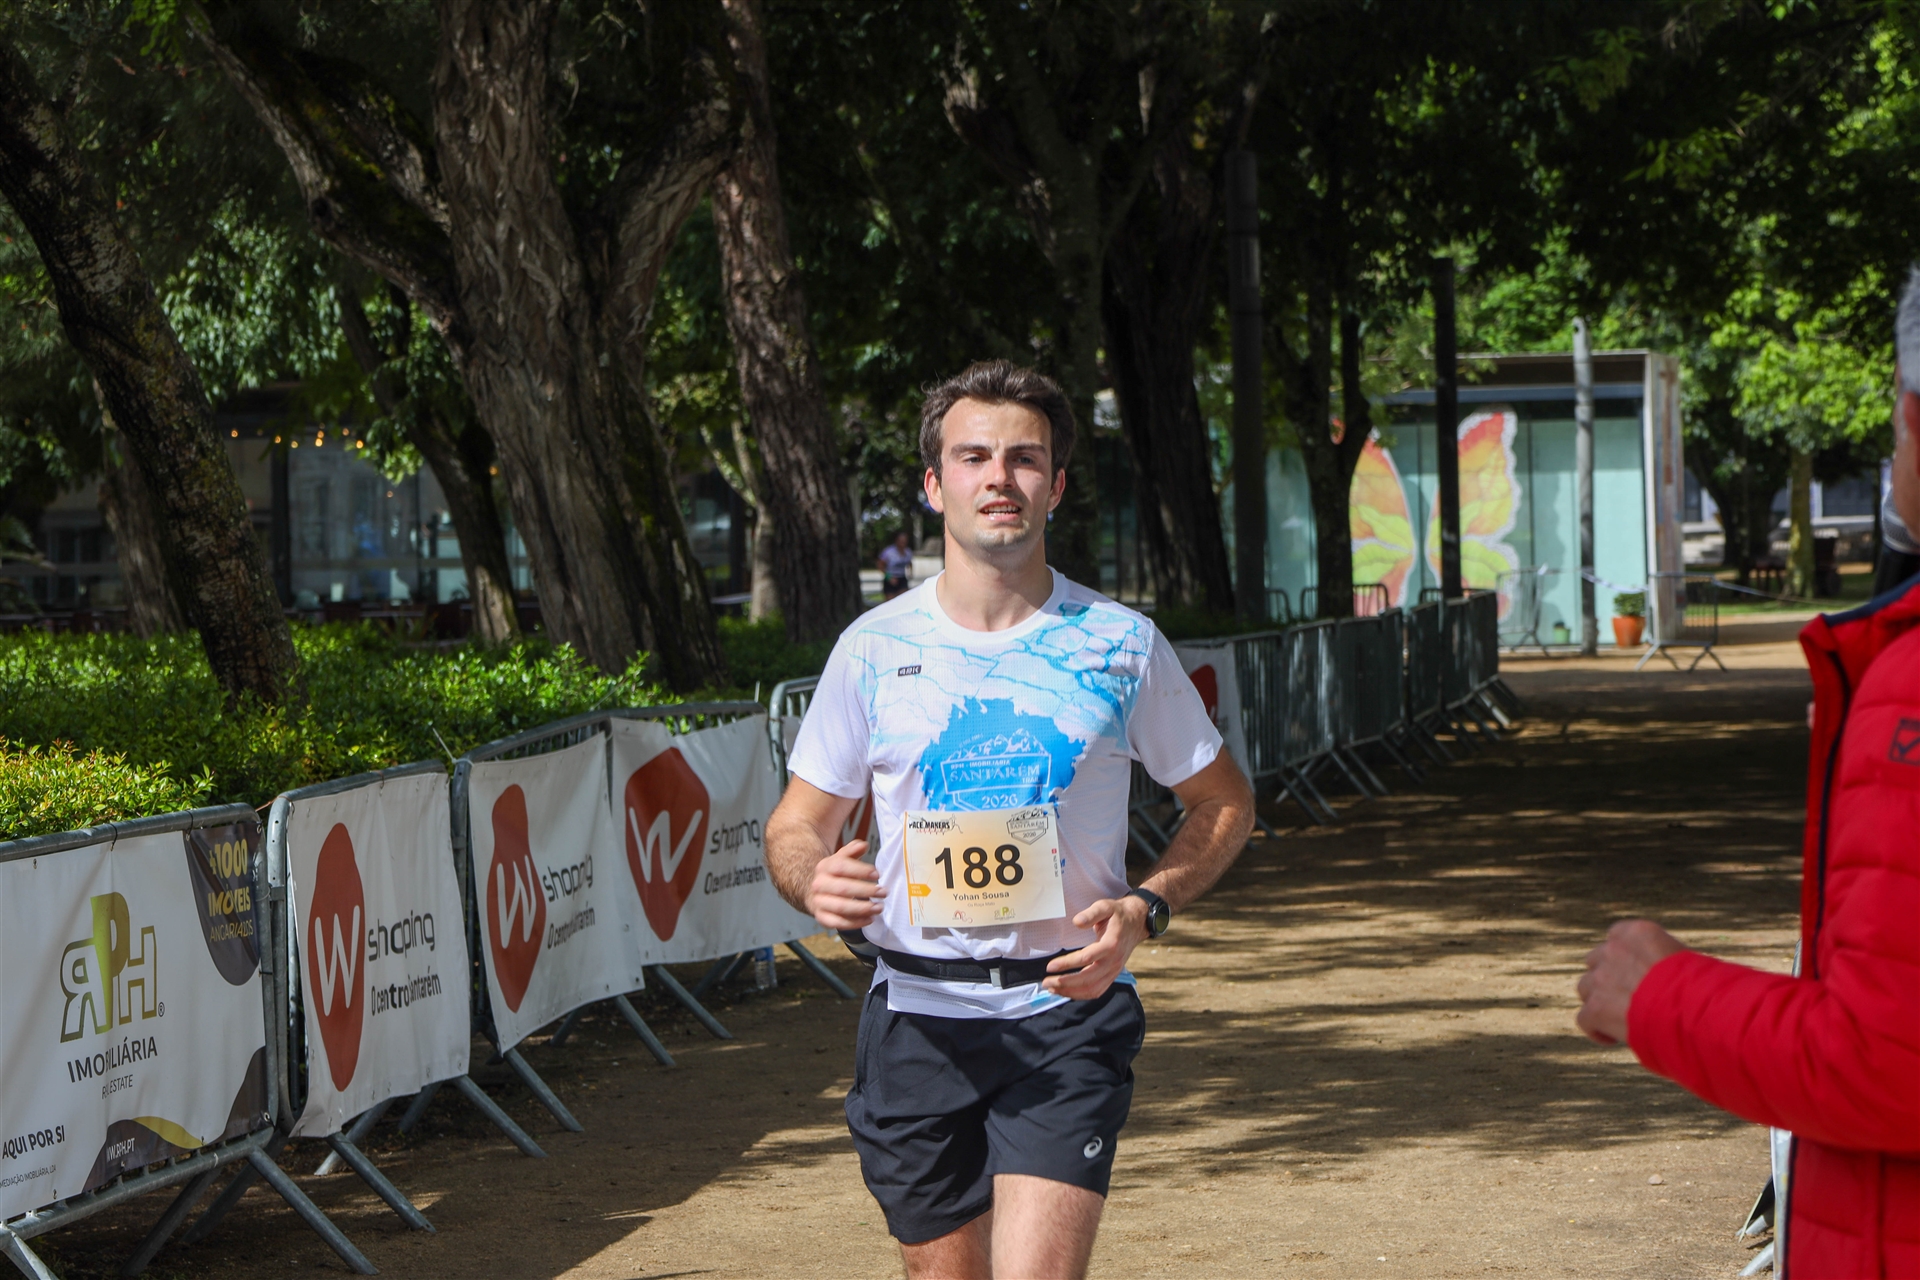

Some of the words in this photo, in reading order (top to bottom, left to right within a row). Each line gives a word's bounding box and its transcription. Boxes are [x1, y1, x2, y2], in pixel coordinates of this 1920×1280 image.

[950, 762, 1040, 782] SANTARÉM
[981, 793, 1018, 809] 2026
[925, 820, 950, 829] MAKERS
[209, 838, 248, 879] +1000
[935, 844, 1024, 889] 188
[953, 893, 980, 902] Yohan
[982, 891, 1010, 901] Sousa
[377, 983, 410, 1014] centro
[109, 1074, 133, 1095] ESTATE
[2, 1136, 28, 1160] AQUI
[28, 1129, 55, 1150] POR
[56, 1125, 65, 1144] SI
